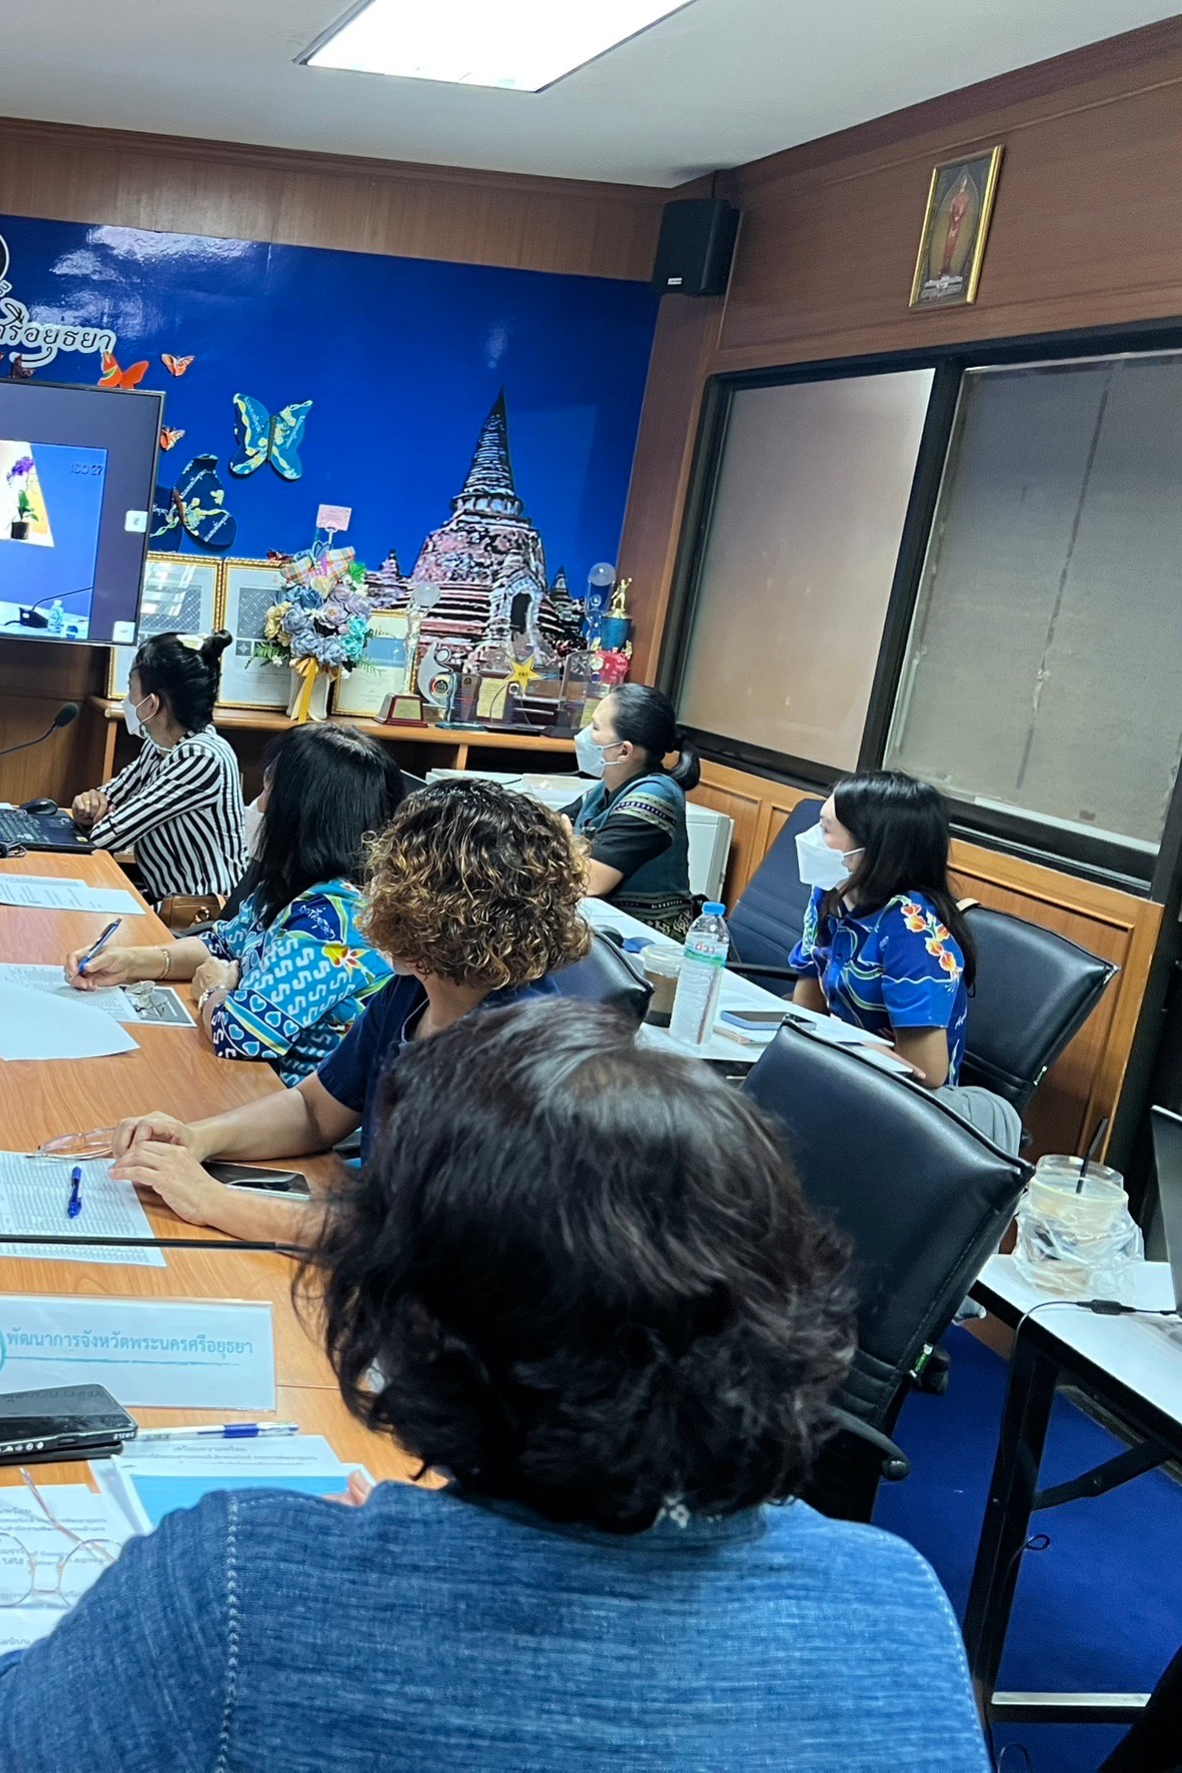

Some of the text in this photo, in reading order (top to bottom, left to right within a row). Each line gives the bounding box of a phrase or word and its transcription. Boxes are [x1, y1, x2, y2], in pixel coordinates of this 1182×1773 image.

[5, 1326, 254, 1359] พัฒนาการจังหวัดพระนครศรีอยุธยา
